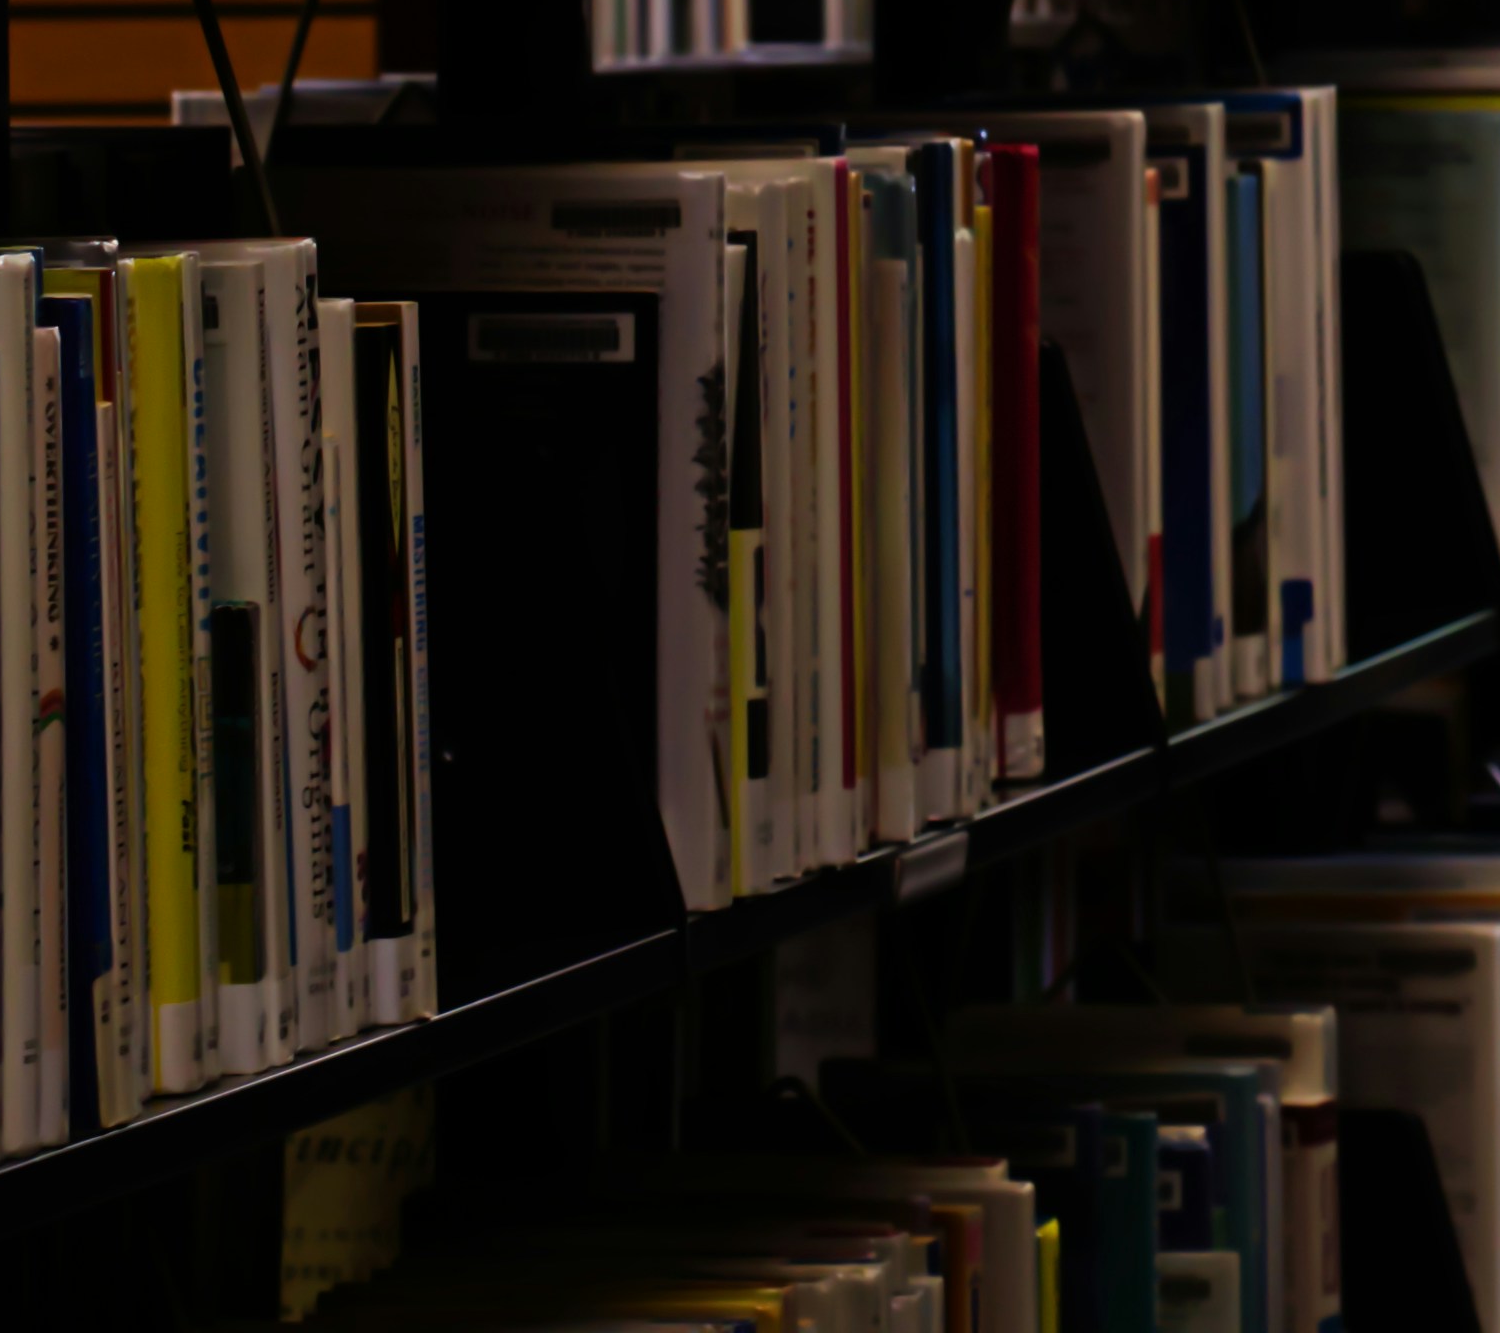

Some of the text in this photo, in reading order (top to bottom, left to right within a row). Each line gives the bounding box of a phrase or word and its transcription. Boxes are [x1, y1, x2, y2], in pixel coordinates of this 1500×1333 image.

[412, 365, 420, 451] MAISEL
[45, 401, 60, 623] OVERTHINKING
[295, 284, 327, 920] Adam Grant Originals
[412, 514, 427, 652] MASTERING
[178, 613, 189, 670] Learn
[178, 678, 190, 774] Anything
[416, 667, 428, 773] CREATIVE
[181, 799, 195, 855] Fast
